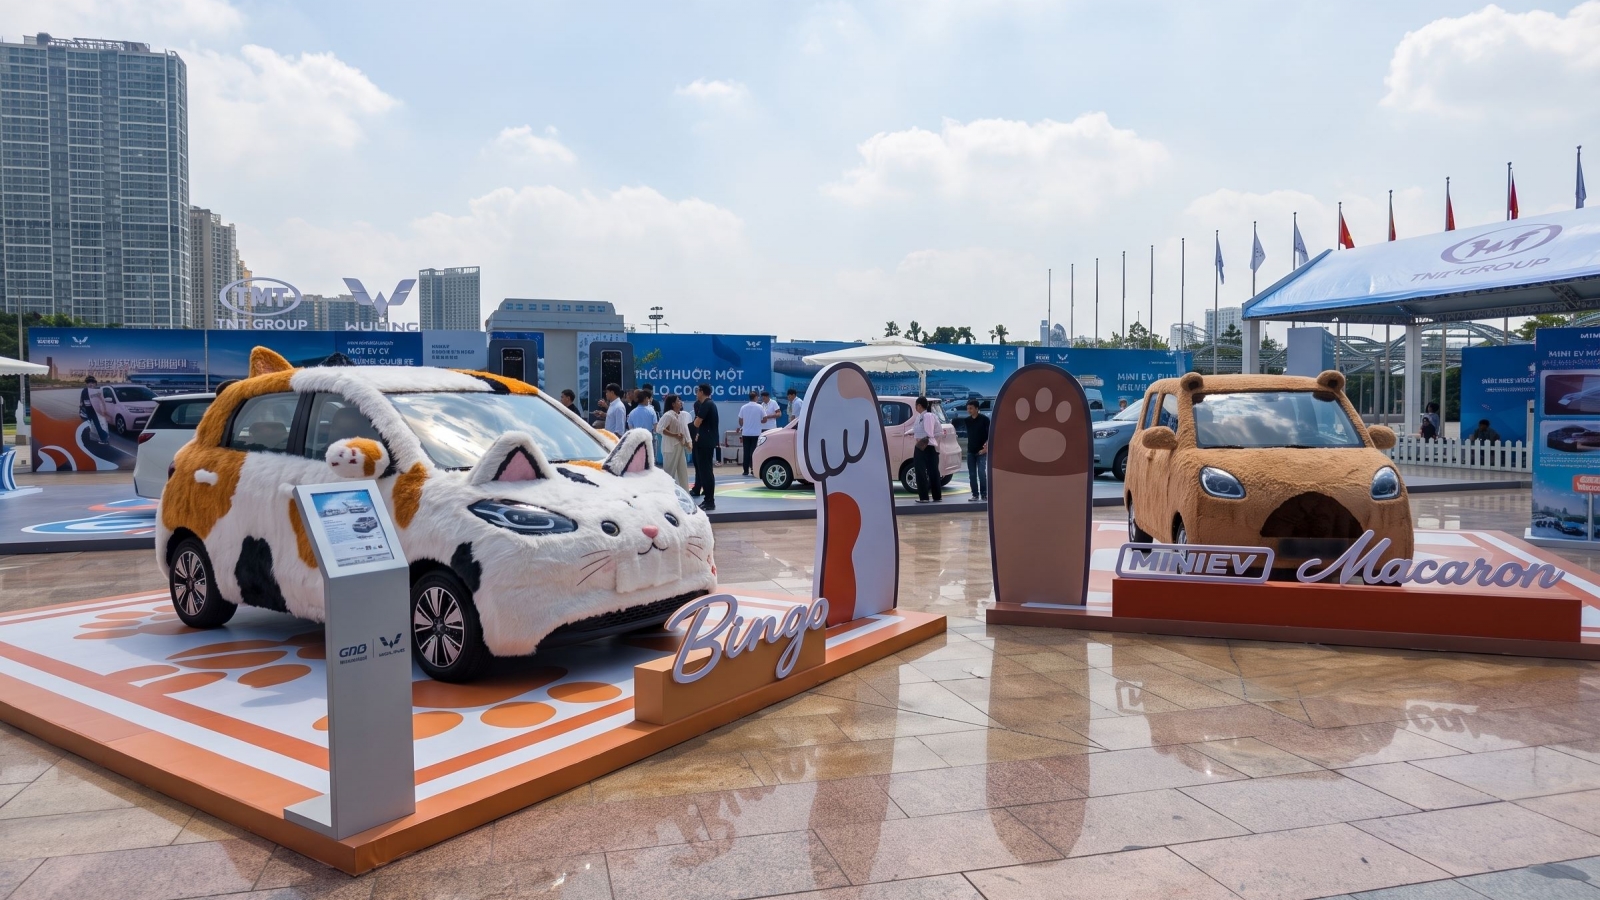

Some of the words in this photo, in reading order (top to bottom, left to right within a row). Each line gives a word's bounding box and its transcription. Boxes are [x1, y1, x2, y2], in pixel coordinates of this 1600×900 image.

[234, 286, 289, 307] TMT
[216, 318, 249, 330] TNT
[252, 319, 308, 330] GROUP
[344, 321, 419, 332] WULING
[1296, 529, 1566, 589] Macaron
[664, 593, 829, 684] Bingo
